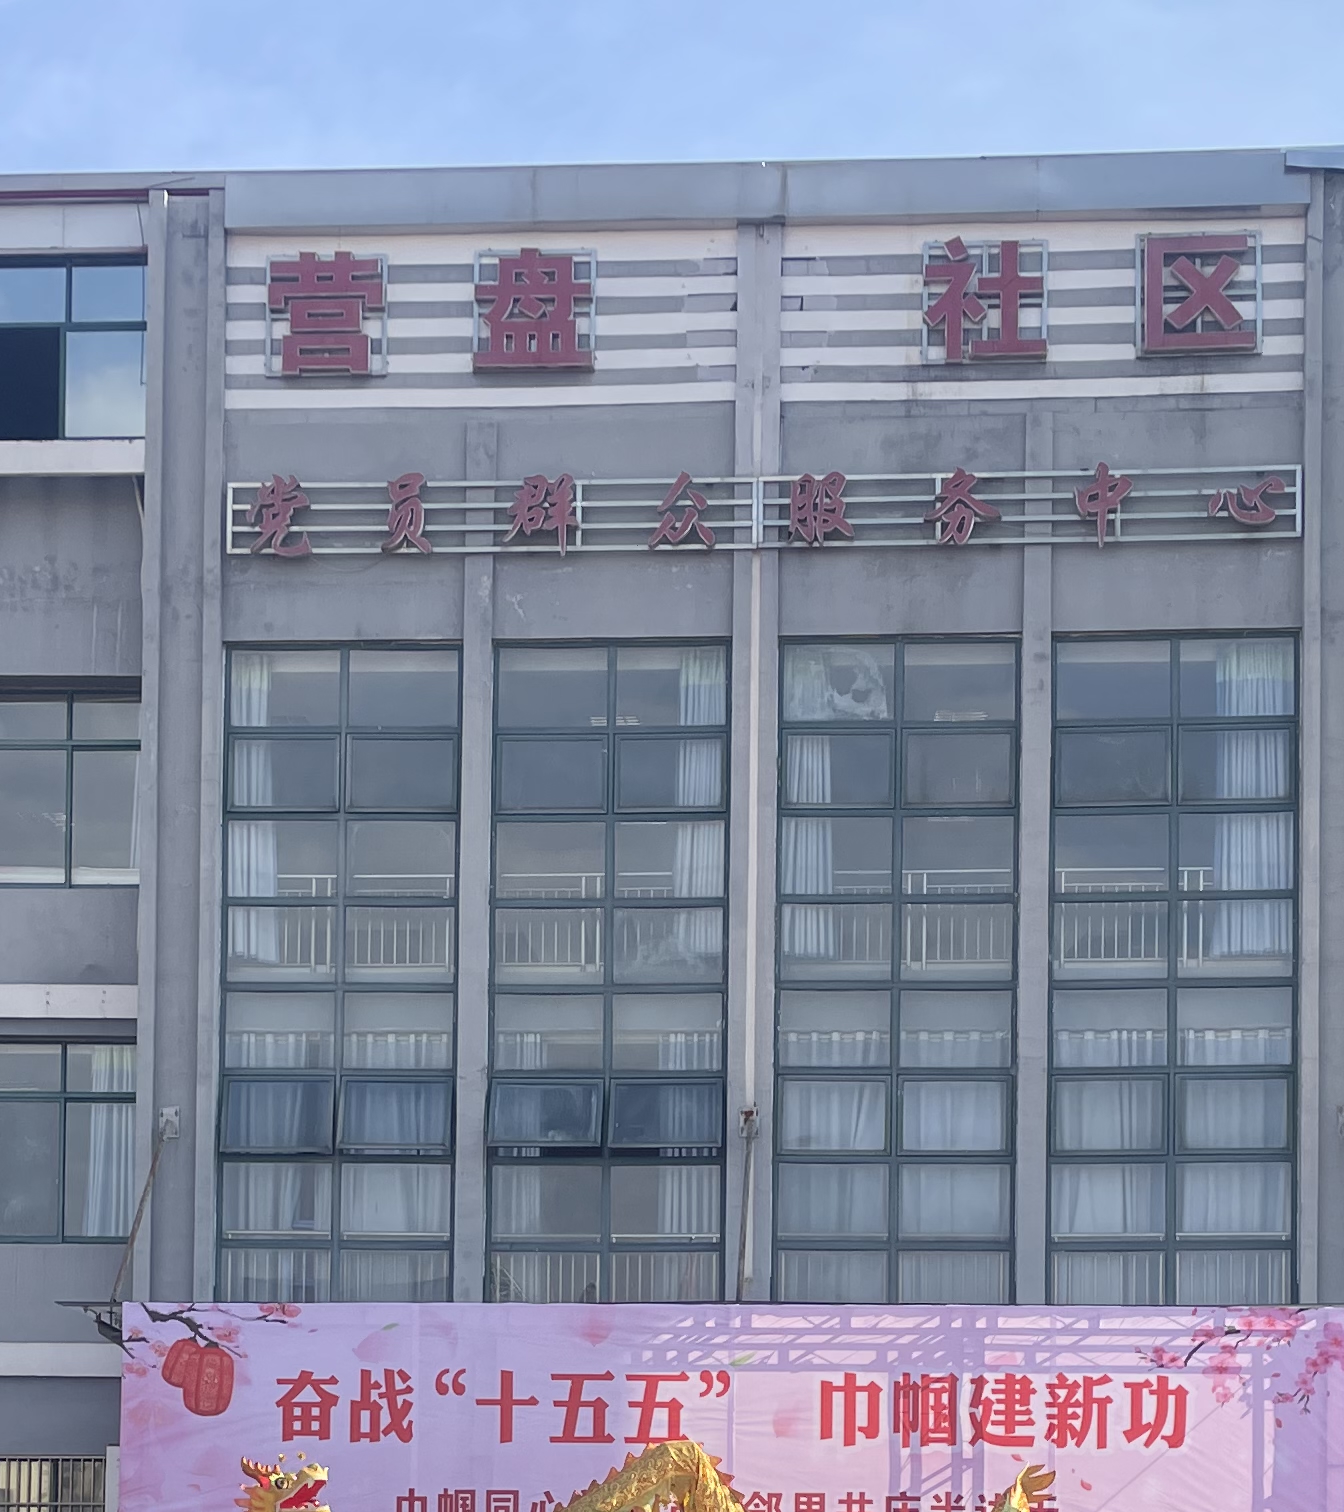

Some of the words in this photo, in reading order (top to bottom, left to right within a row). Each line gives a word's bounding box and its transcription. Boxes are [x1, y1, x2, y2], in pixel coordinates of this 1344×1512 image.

[248, 462, 1287, 556] 党员群众服务中心
[819, 1371, 1189, 1450] 巾帼建新功
